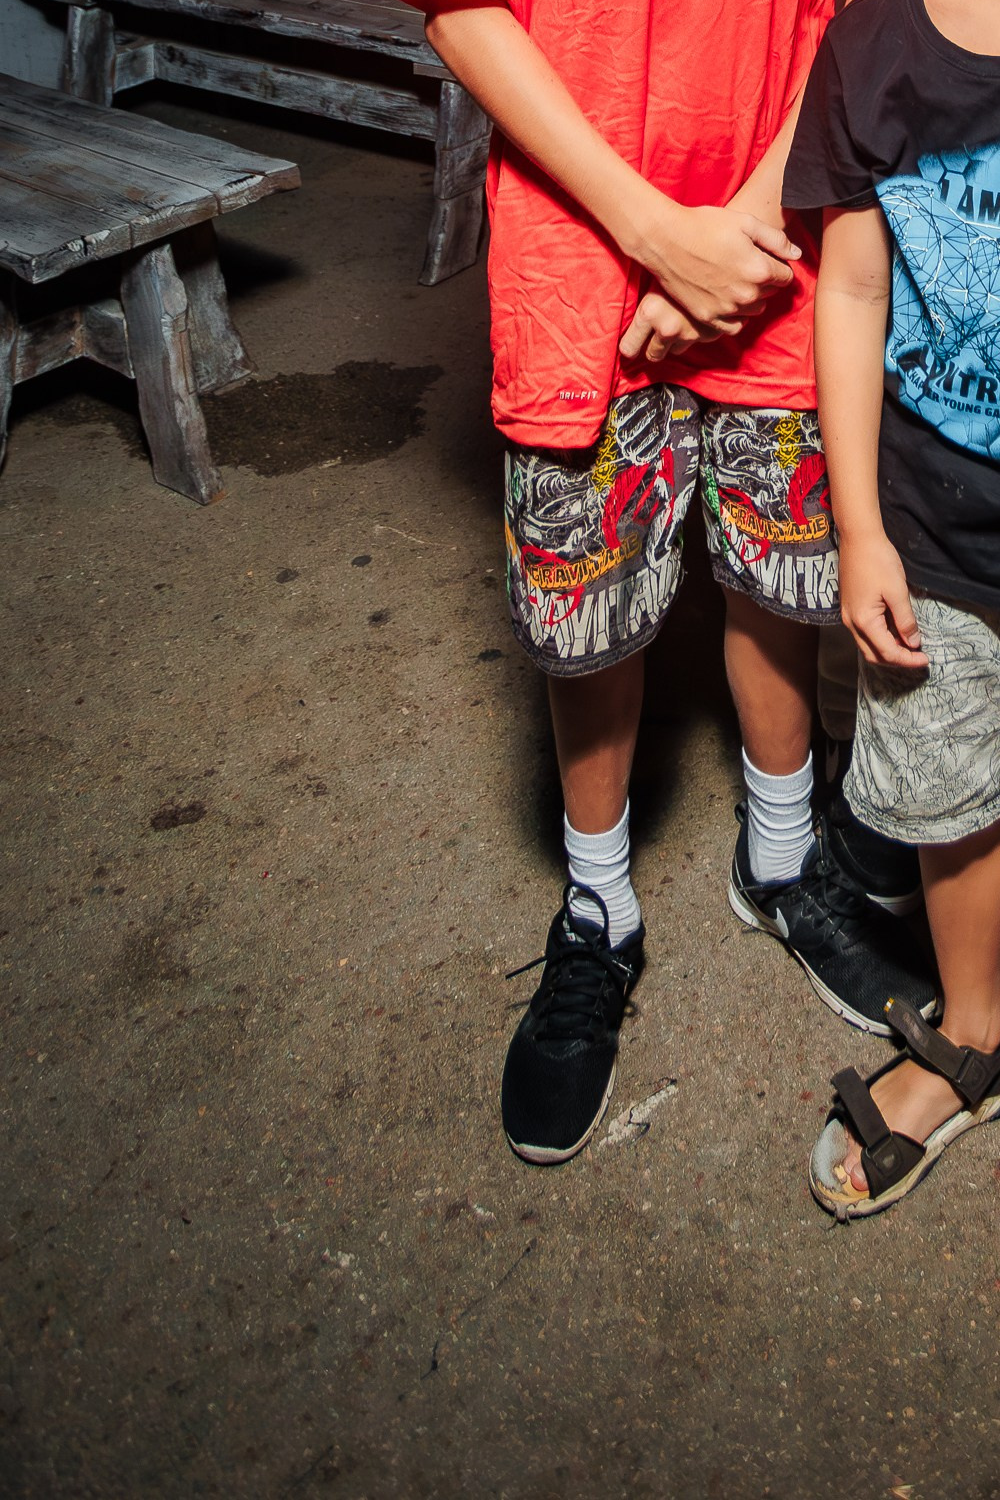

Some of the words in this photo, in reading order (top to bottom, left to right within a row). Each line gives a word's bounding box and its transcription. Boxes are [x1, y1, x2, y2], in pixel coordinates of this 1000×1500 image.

[940, 178, 950, 203] I
[559, 390, 598, 400] DRI-FIT
[943, 394, 982, 415] YOUNG
